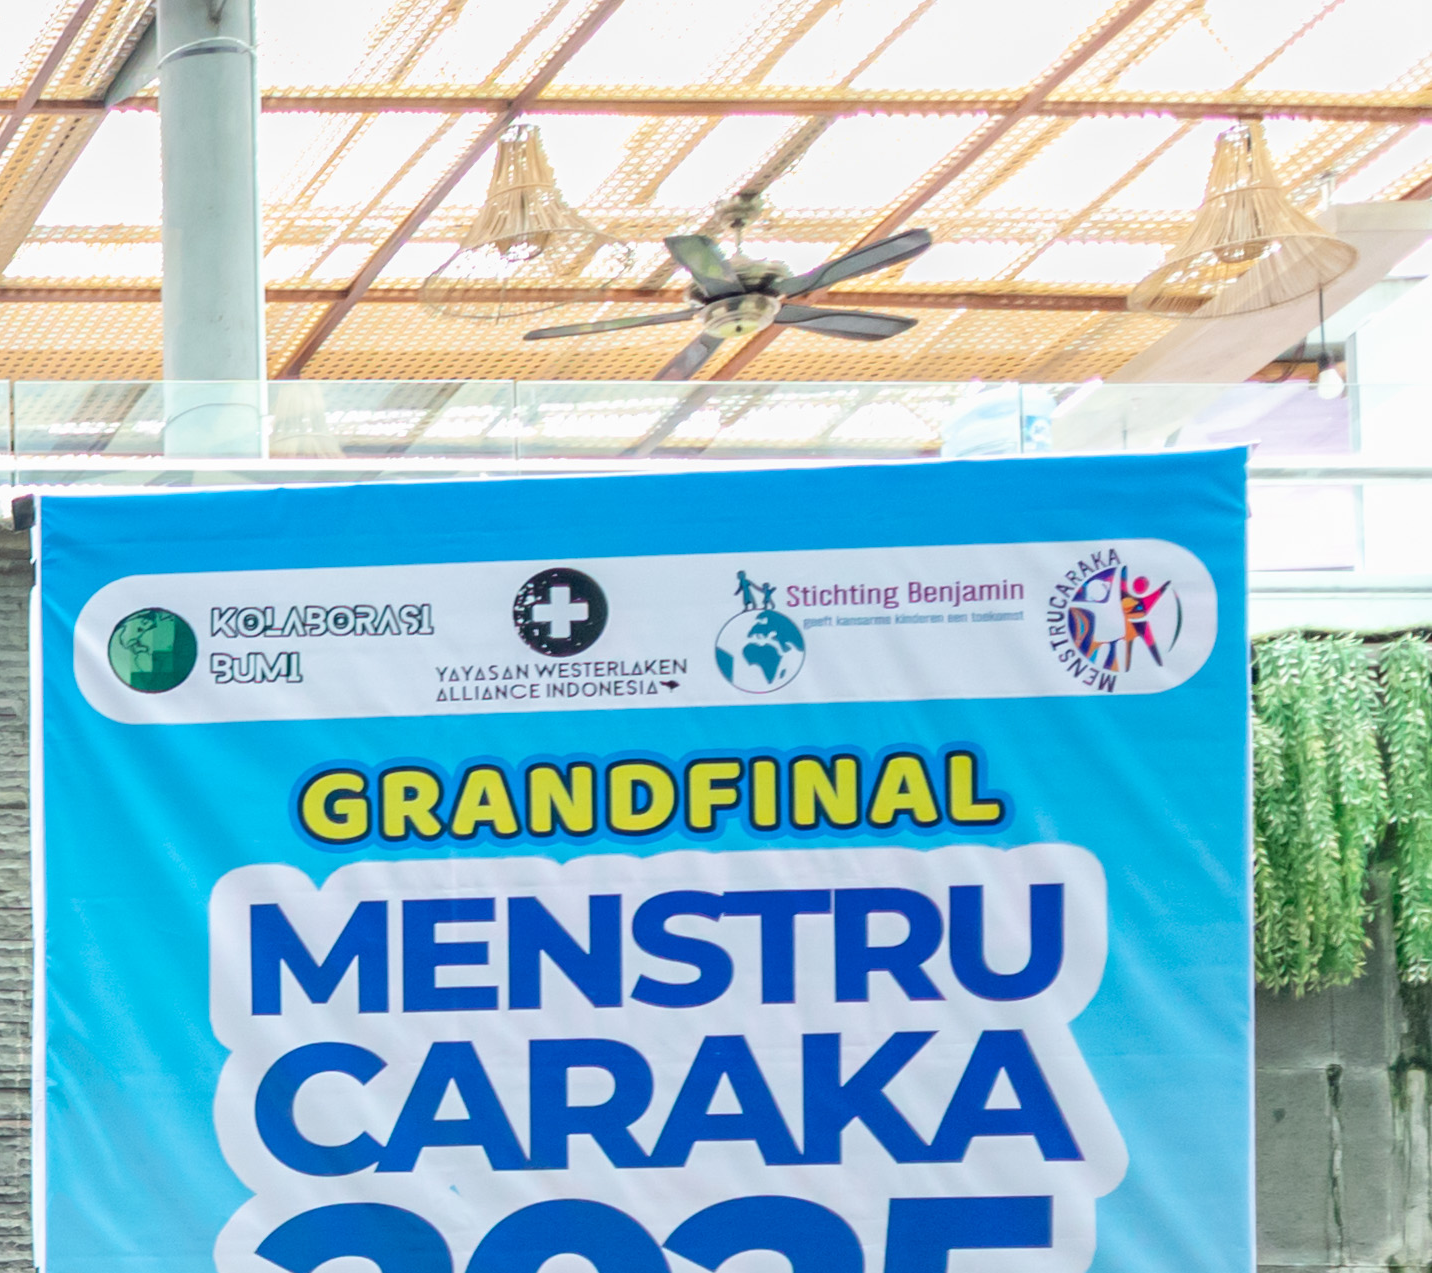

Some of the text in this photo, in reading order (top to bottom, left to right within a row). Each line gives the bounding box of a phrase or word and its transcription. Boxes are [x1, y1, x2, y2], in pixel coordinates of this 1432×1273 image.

[786, 580, 1025, 609] Stichting Benjamin
[210, 603, 434, 638] KOLABORASI
[1048, 548, 1122, 693] MENSTRUCARAKA
[210, 651, 303, 684] BUMI
[436, 658, 687, 682] YAYASAN WESTERLAKEN
[436, 679, 659, 702] ALLIANCE INDONESIA
[297, 752, 1005, 844] GRANDFINAL
[249, 883, 1065, 1017] MENSTRU
[254, 1029, 1085, 1177] CARAKA
